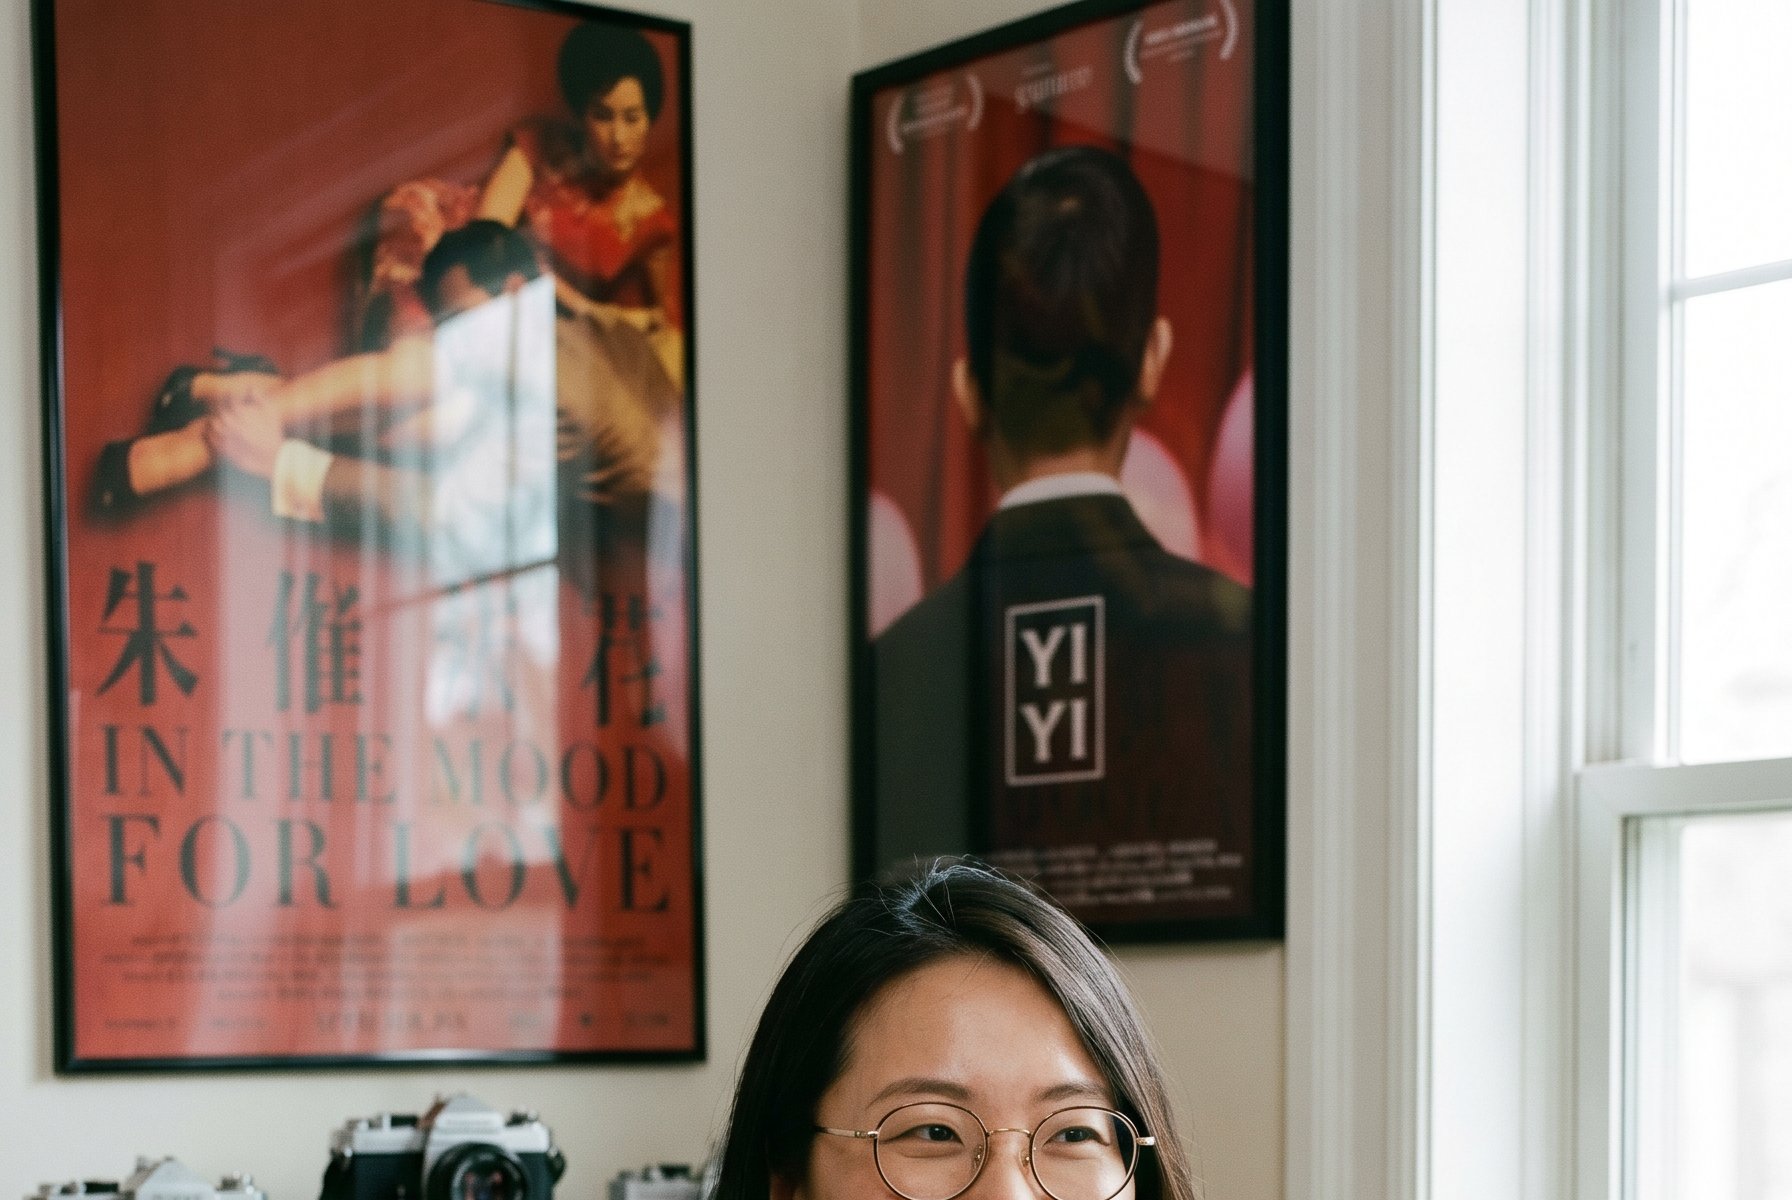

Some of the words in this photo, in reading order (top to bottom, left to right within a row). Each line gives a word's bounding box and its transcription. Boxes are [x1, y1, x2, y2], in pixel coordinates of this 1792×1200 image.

[1020, 621, 1090, 690] YI
[101, 724, 189, 797] IN
[221, 729, 395, 805] THE
[432, 741, 669, 815] MOOD
[1019, 696, 1090, 765] YI
[100, 813, 338, 910] FOR
[391, 822, 670, 915] LOVE
